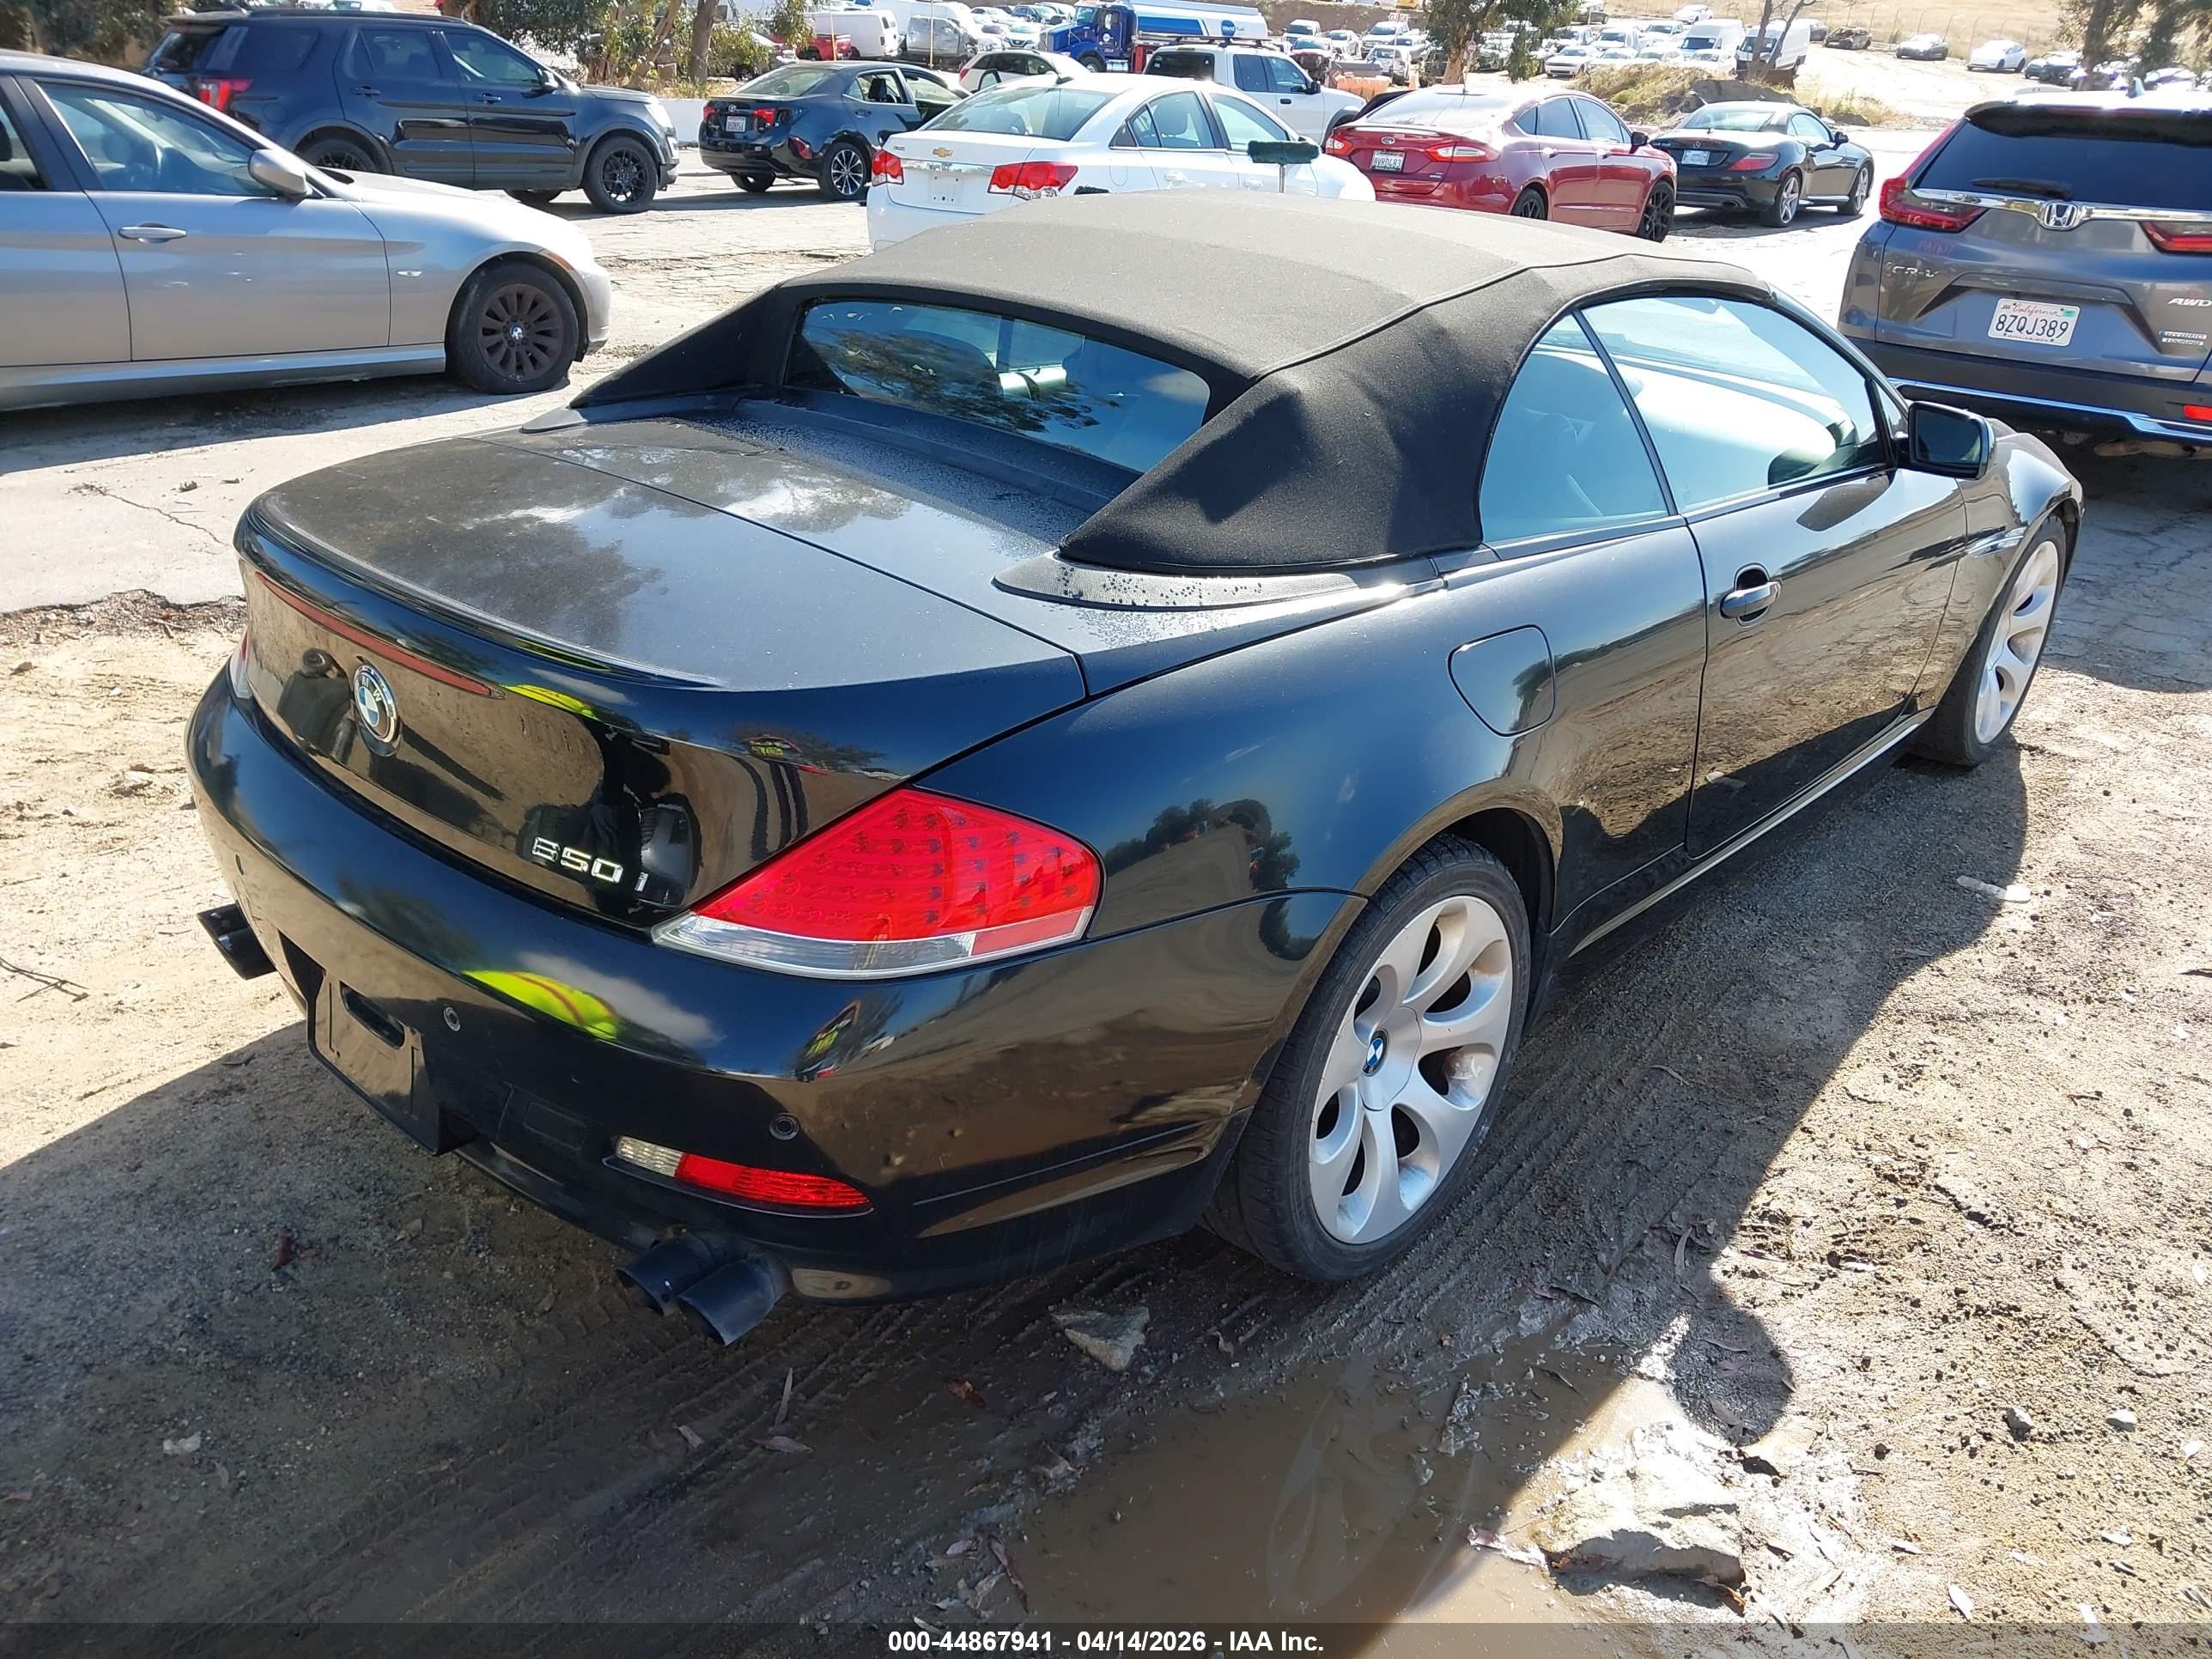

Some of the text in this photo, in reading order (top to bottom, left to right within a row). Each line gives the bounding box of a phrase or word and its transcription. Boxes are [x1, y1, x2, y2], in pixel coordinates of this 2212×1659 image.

[1892, 265, 1940, 277] CR-V
[2168, 297, 2212, 307] AWD
[2013, 303, 2062, 318] California
[1995, 313, 2069, 339] 8ZQJ389
[2165, 331, 2207, 339] HYBRID
